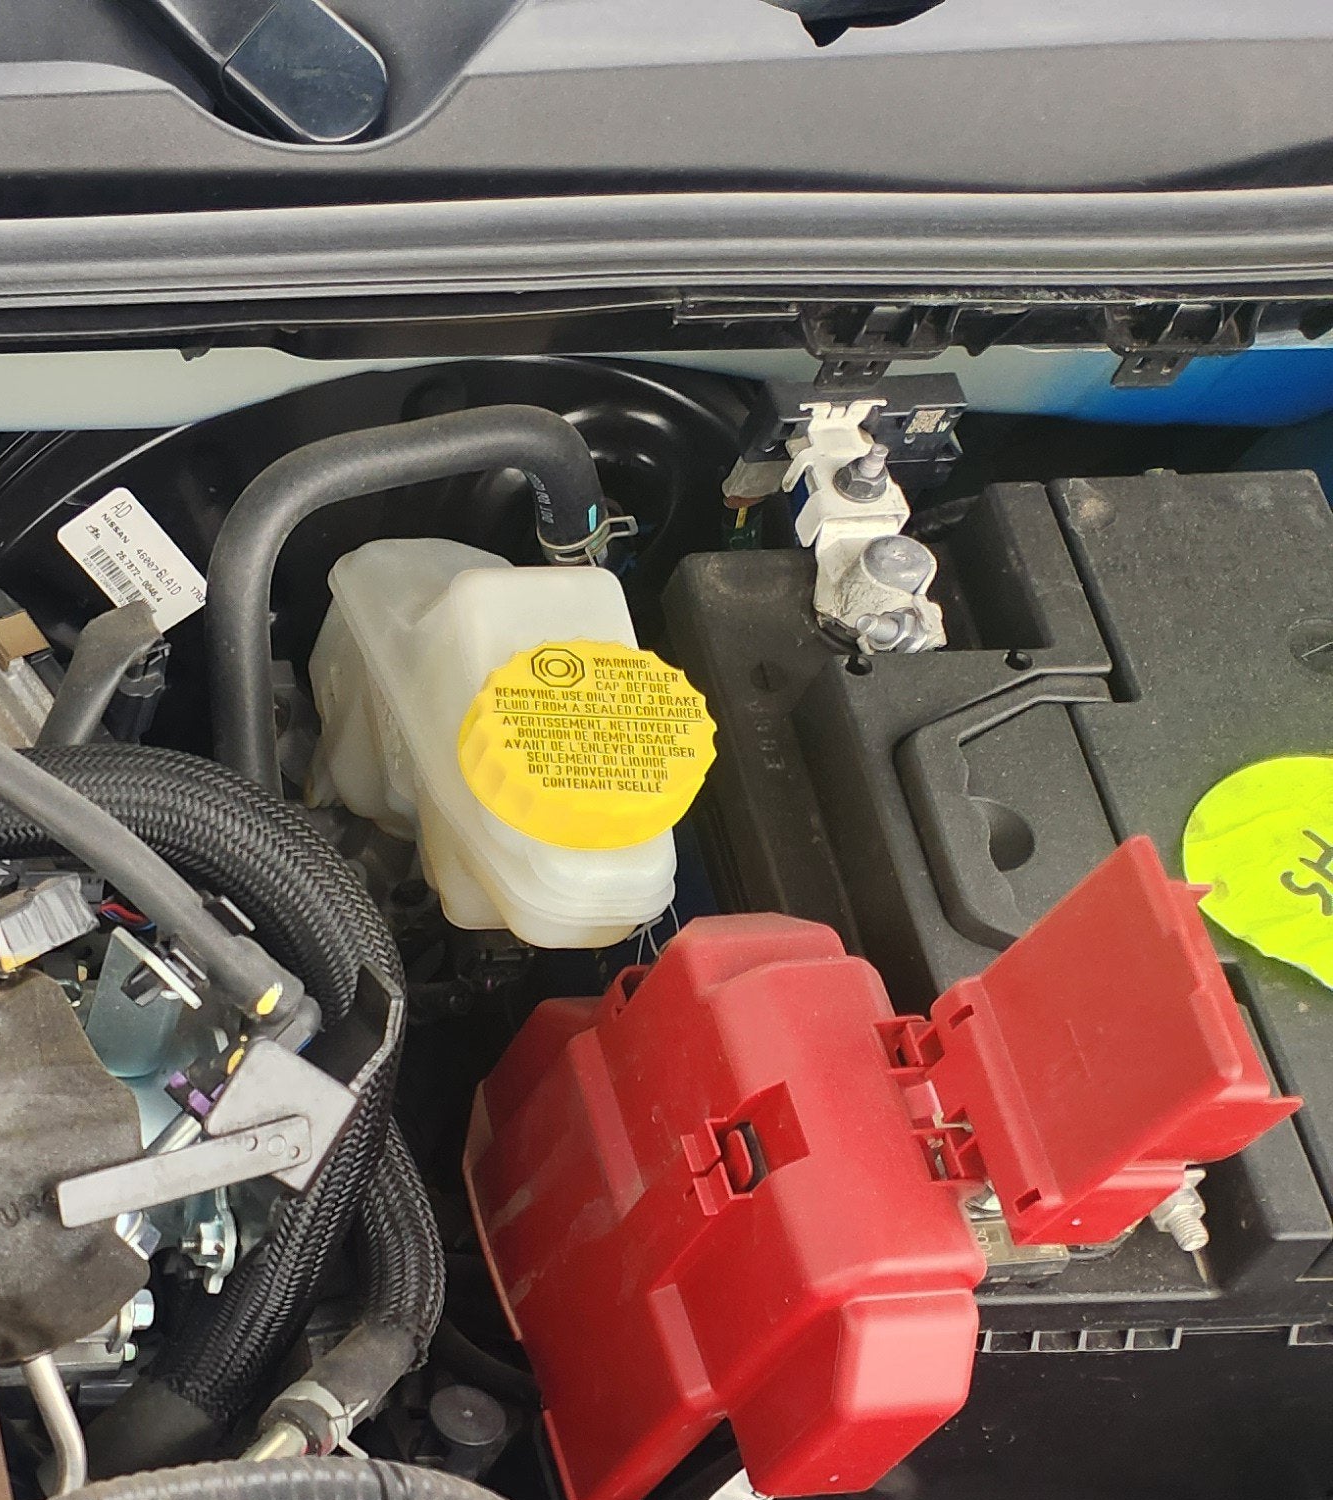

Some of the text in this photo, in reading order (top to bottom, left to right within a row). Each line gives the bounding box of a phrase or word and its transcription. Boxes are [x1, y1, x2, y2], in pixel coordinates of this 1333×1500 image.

[110, 500, 133, 519] AD
[101, 513, 130, 544] NISSAN
[593, 658, 650, 669] WARNING:
[595, 670, 678, 682] CLEAN FILLER
[596, 681, 671, 694] CAP BEFORE
[496, 699, 529, 710] FLUID
[534, 701, 567, 712] FROM
[572, 703, 580, 713] A
[585, 703, 632, 715] SEALED
[562, 691, 583, 701] USE
[586, 692, 616, 703] ONLY
[621, 694, 642, 704] DOT
[648, 695, 654, 705] 3
[659, 695, 698, 707] BRAKE
[611, 720, 673, 733] NETTOYER
[675, 724, 690, 734] LE
[518, 728, 677, 745] BOUCHON DE REMPLISSAGE
[505, 739, 544, 751] AVANT
[551, 741, 564, 751] DE
[642, 746, 695, 758] UTILISER
[527, 752, 667, 768] SEULEMENT DU LIQUIDE
[528, 764, 549, 774] DOT
[556, 766, 562, 775] 3
[566, 766, 636, 779] PROVENANT
[543, 777, 612, 790] CONTENANT
